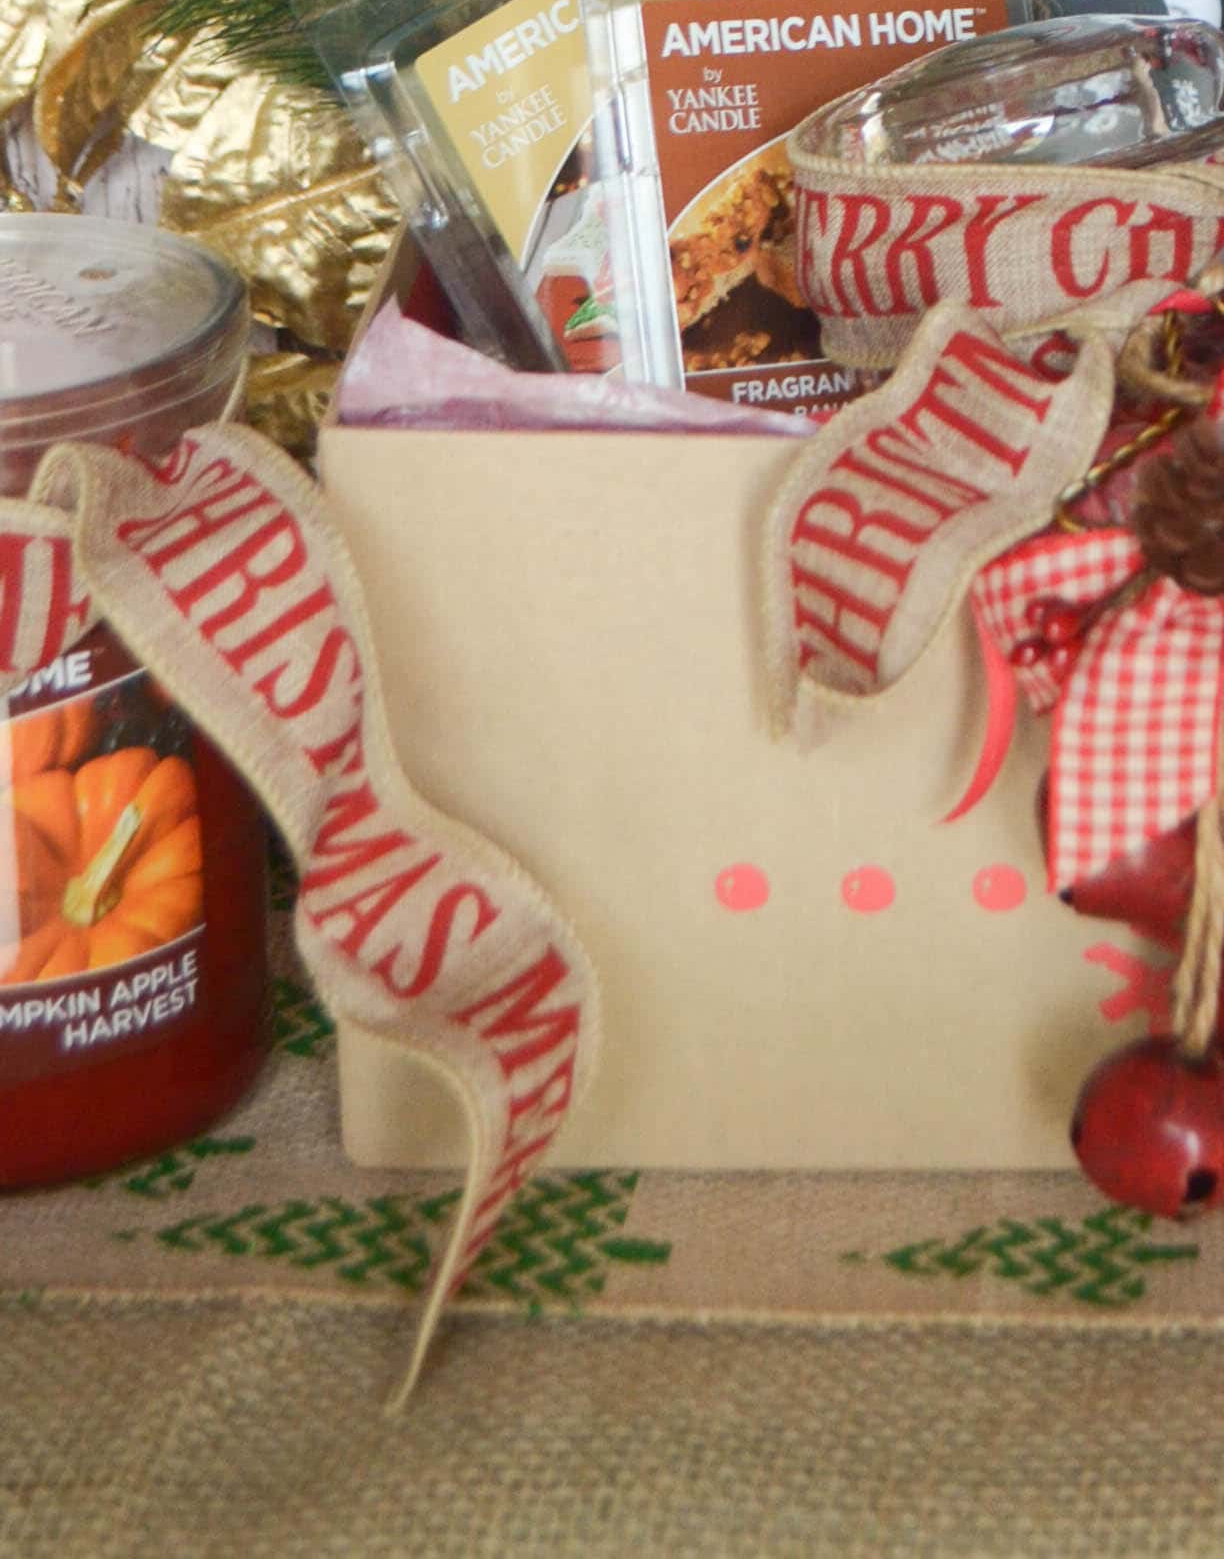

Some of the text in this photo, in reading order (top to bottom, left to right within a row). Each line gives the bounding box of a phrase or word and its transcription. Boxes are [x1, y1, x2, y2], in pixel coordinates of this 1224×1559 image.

[660, 7, 977, 58] AMERICAN HOME
[667, 83, 759, 110] YANKEE
[703, 65, 723, 83] by
[470, 84, 557, 146] YANKEE
[480, 104, 568, 170] CANDLE
[669, 108, 763, 134] CANDLE
[731, 370, 852, 404] FRAGRAN
[110, 949, 198, 1008] APPLE
[63, 978, 199, 1051] HARVEST
